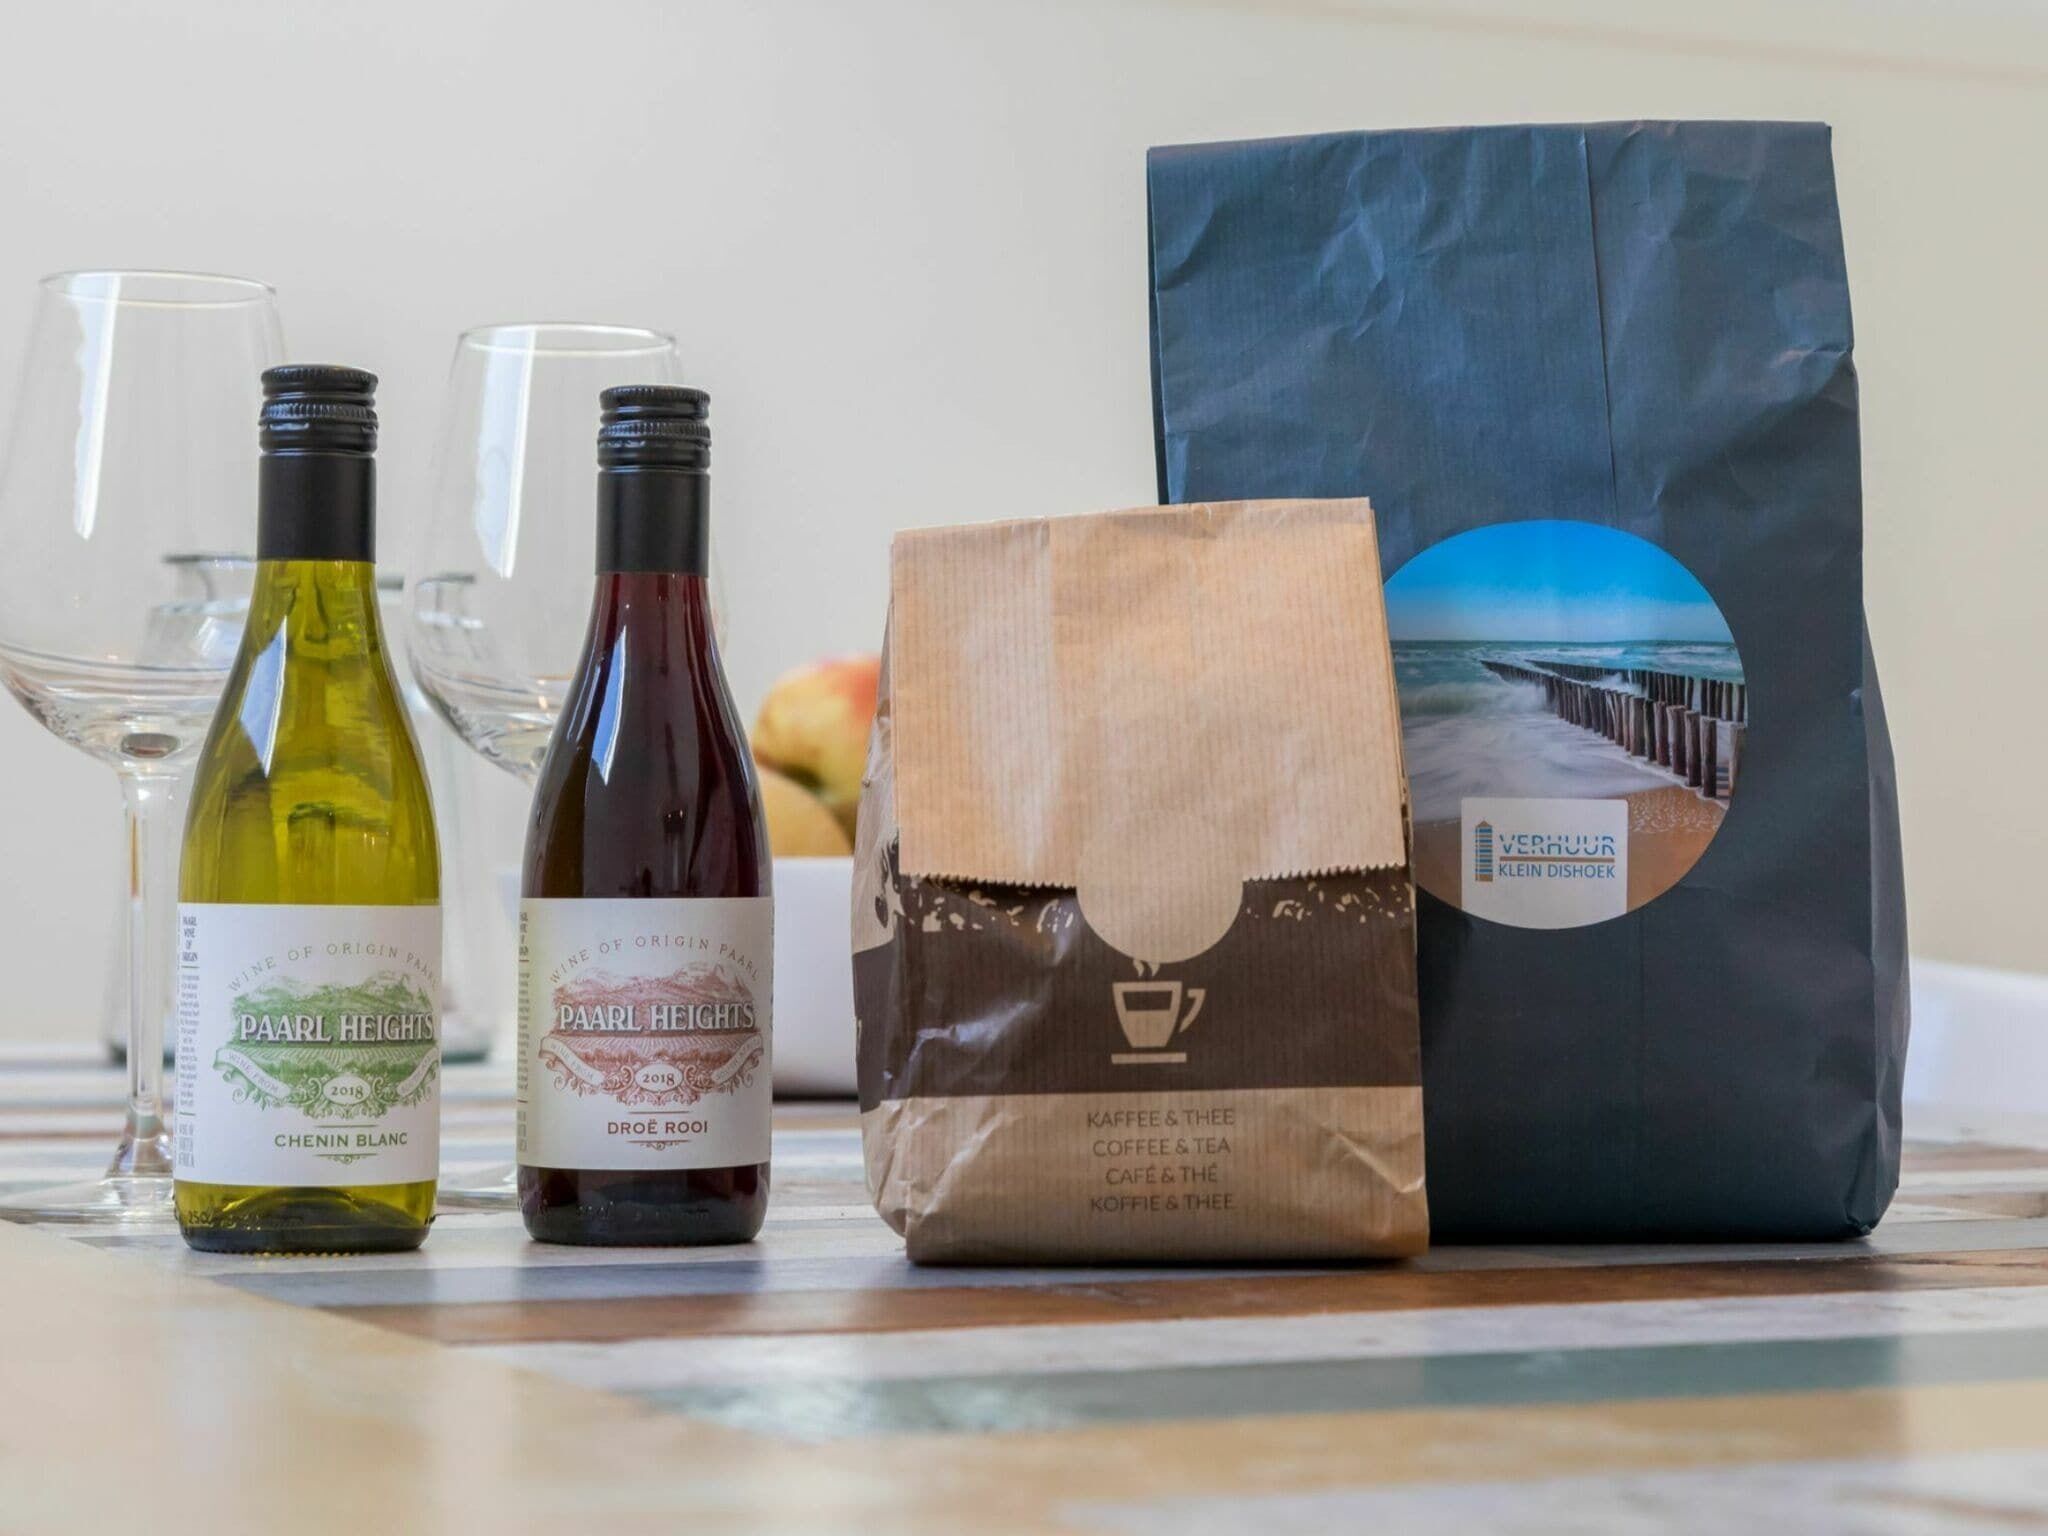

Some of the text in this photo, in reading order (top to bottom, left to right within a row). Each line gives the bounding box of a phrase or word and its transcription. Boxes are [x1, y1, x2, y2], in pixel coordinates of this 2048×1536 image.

[1499, 834, 1615, 856] VERHUUR
[1499, 863, 1616, 879] KLEIN DISHOEK
[228, 956, 277, 992] WINE
[288, 945, 313, 961] OF
[326, 943, 398, 958] ORIGIN
[550, 949, 590, 984] WINE
[600, 938, 624, 954] OF
[635, 934, 710, 951] ORIGIN
[559, 1001, 756, 1032] PAARL HEIGHTS
[239, 1011, 435, 1044] PAARL HEIGHTS
[642, 1072, 675, 1086] 2018
[331, 1085, 364, 1099] 2018
[607, 1119, 708, 1135] DROË ROOI
[1087, 1108, 1235, 1128] KAFFEE & THEE
[274, 1132, 408, 1148] CHENIN BLANC
[1093, 1137, 1232, 1157] COFFEE & TEA
[1105, 1162, 1218, 1185] CAFÉ & THÉ
[1091, 1193, 1234, 1213] KOFFIE & THEE
